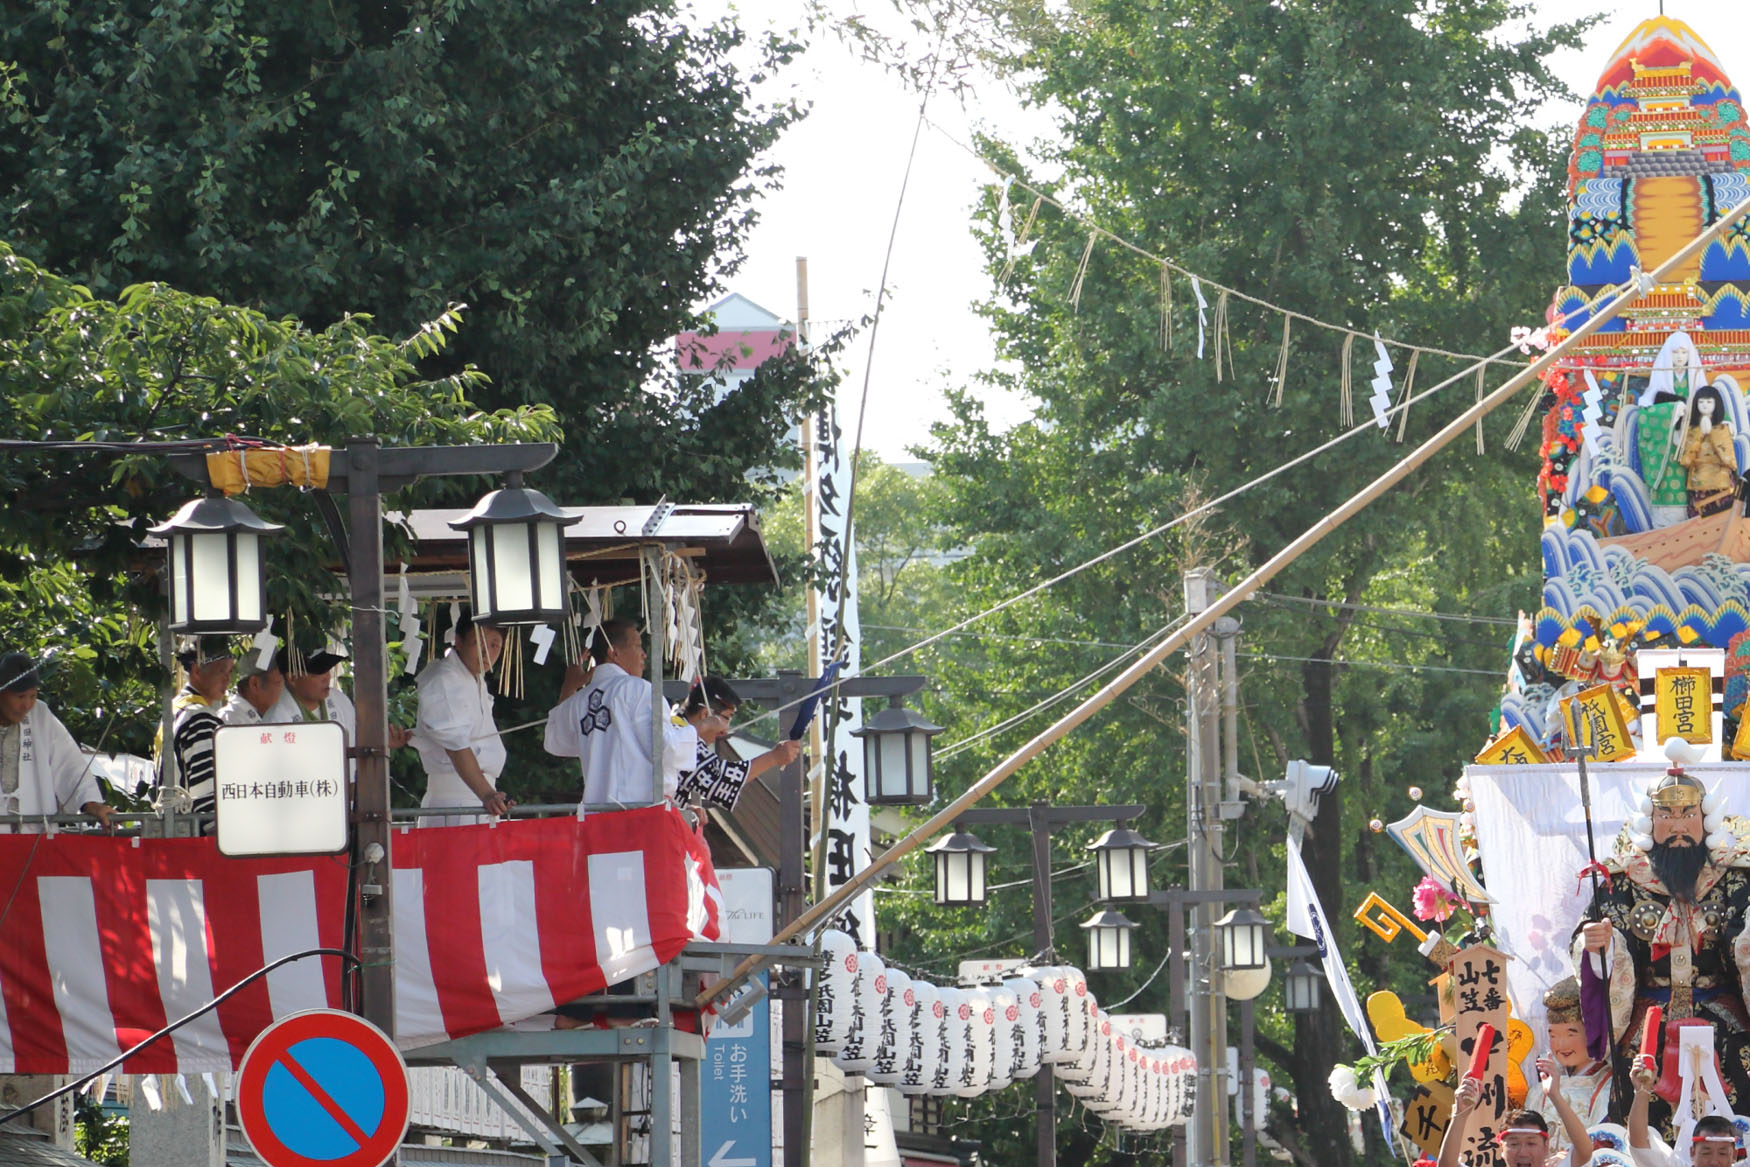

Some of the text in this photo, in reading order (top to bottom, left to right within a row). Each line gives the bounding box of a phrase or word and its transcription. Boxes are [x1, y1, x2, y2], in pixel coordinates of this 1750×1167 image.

[1672, 675, 1696, 734] 櫛田宮
[221, 779, 339, 800] 西日本自動車(株)
[744, 911, 764, 920] LIFE
[1458, 961, 1485, 1015] 山笠
[1482, 959, 1507, 1012] 七番
[713, 1043, 725, 1081] Toilet
[729, 1042, 748, 1123] お手洗い
